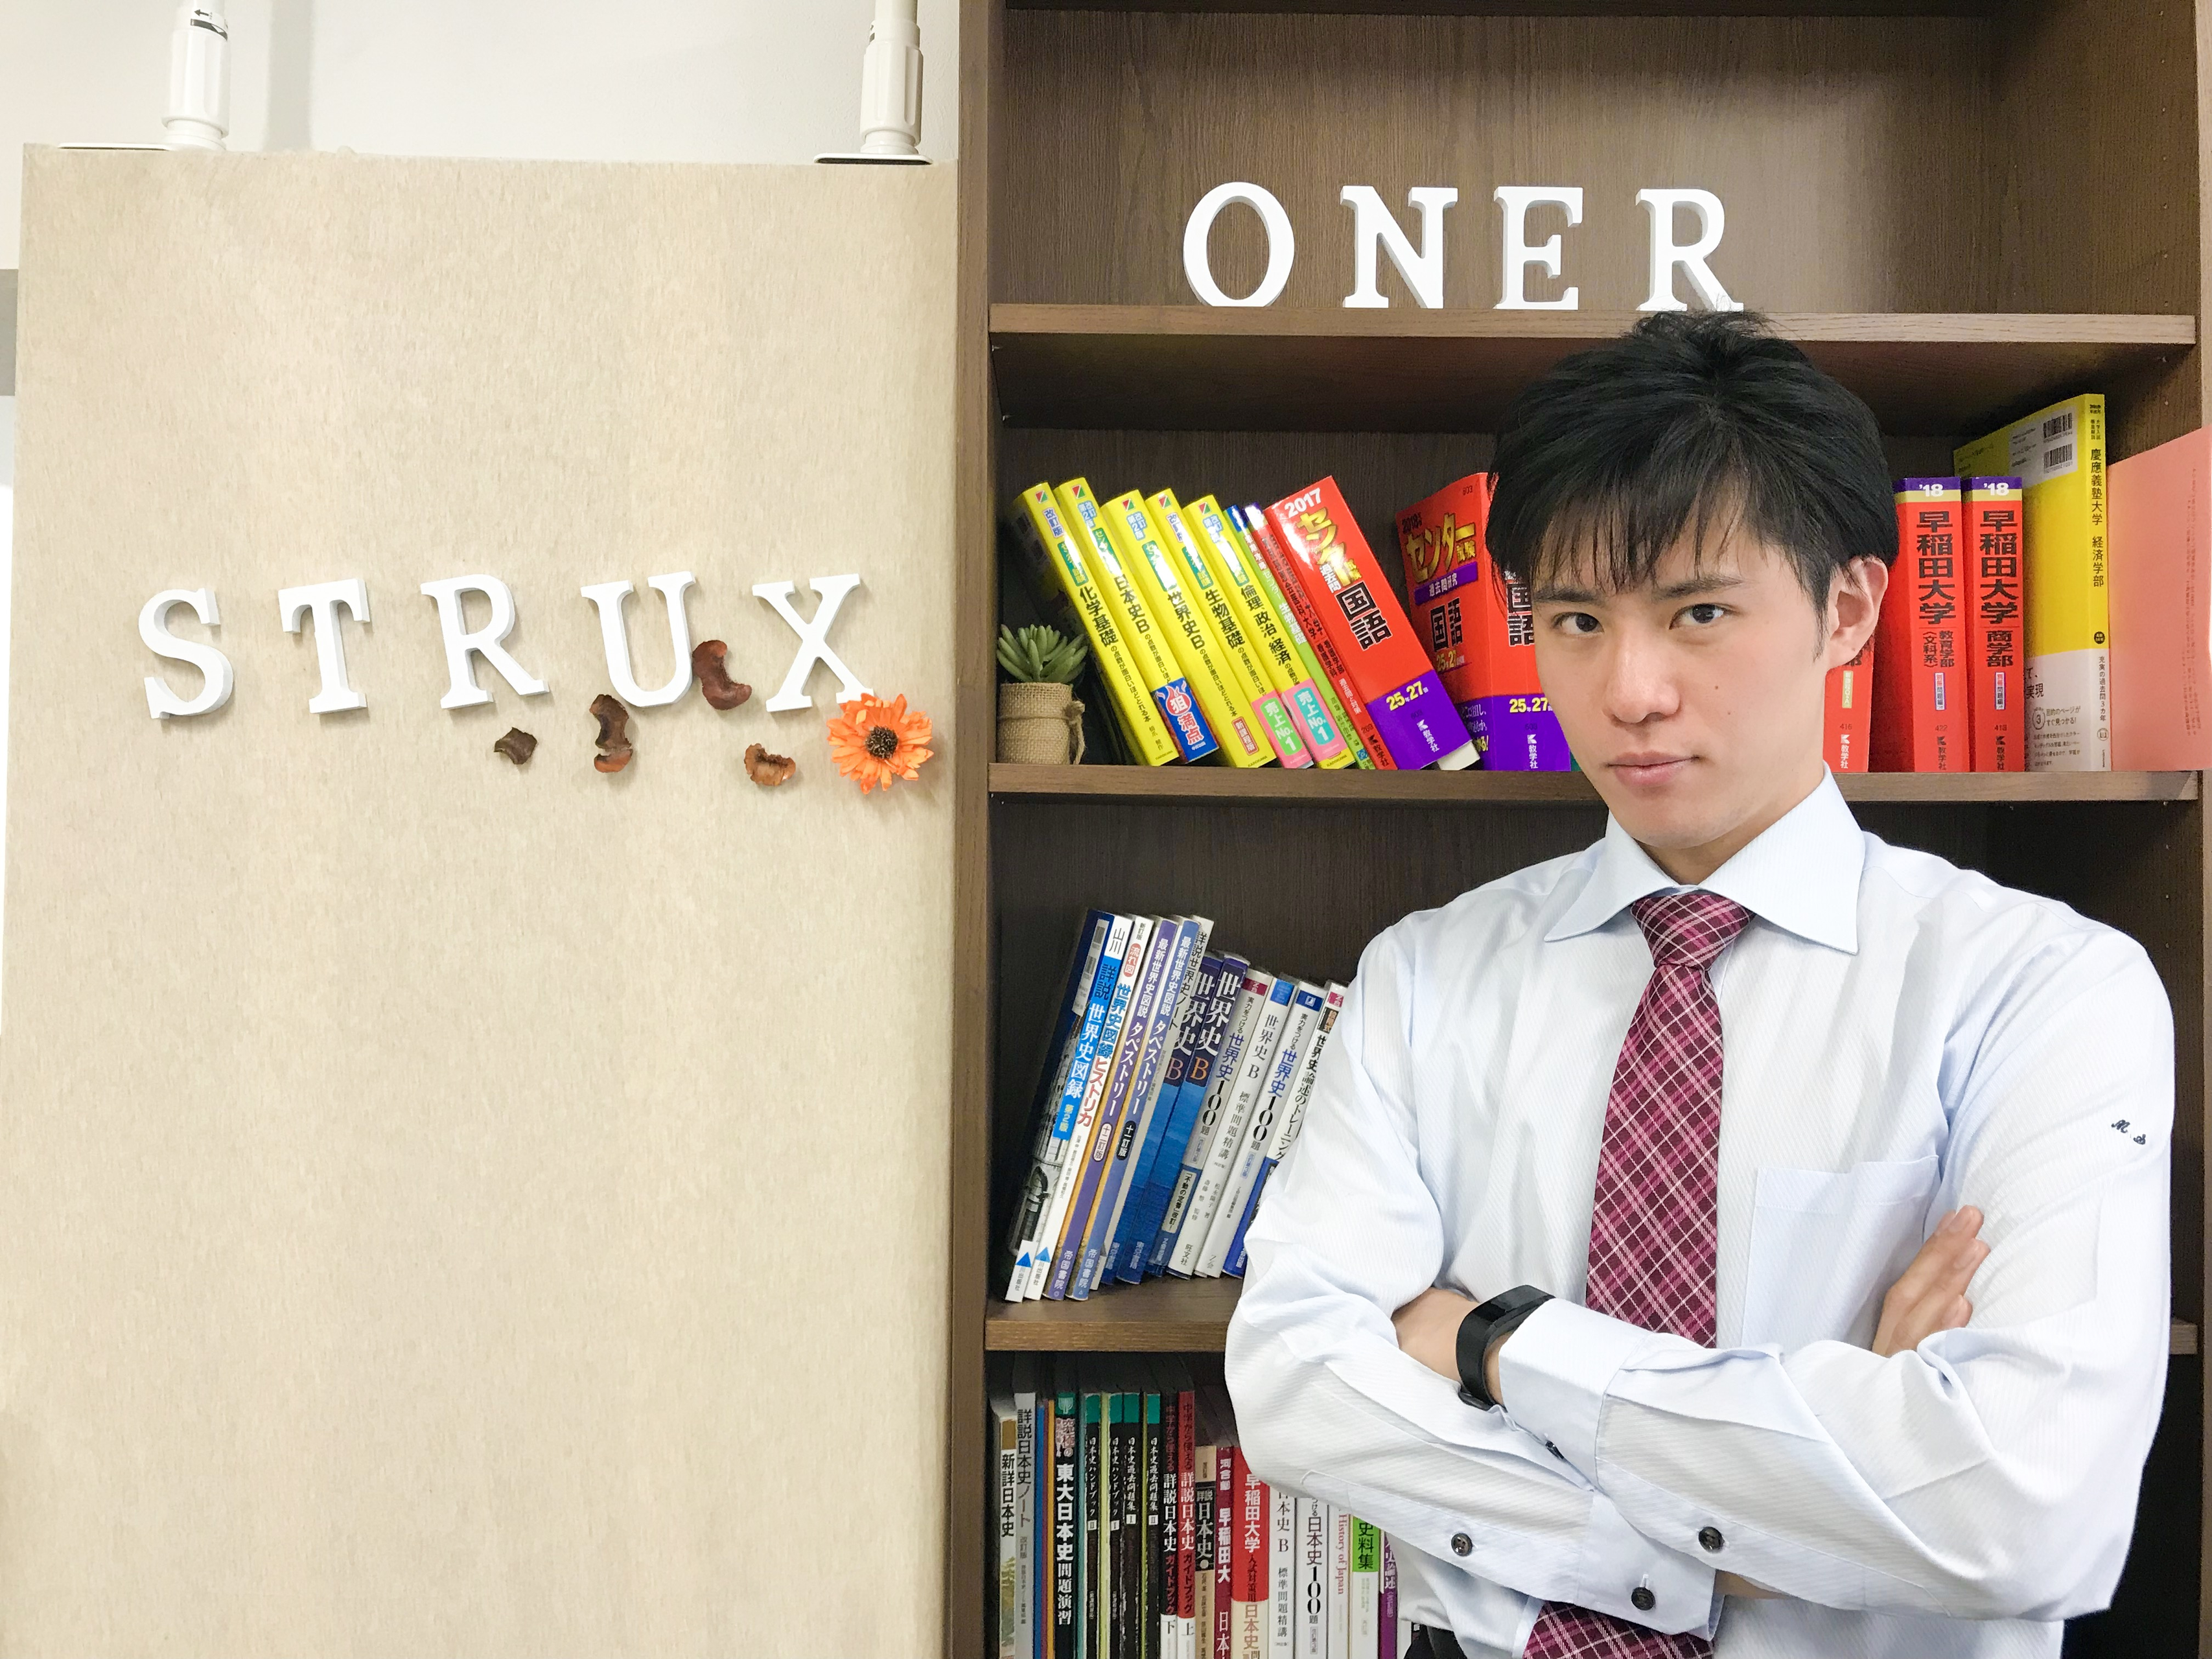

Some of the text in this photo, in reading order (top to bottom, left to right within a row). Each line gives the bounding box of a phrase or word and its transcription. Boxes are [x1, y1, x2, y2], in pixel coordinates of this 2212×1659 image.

[1183, 181, 1744, 311] ONER
[1284, 487, 1321, 518] 2017
[1918, 483, 1944, 498] '18
[1983, 483, 2009, 497] '18
[2090, 448, 2103, 526] 慶應義塾大学
[1406, 512, 1476, 584] センター
[1916, 510, 1956, 625] 早稲田大学
[1979, 509, 2019, 625] 早稲田大学
[2091, 535, 2105, 588] 経済学部
[1080, 585, 1118, 645] 化学基礎
[1113, 574, 1150, 633] 日本史B
[1167, 585, 1206, 651] 世界史B
[1204, 588, 1246, 650] 生物基礎
[1279, 601, 1308, 645] 生物基礎
[1336, 581, 1393, 652] 国語
[1430, 596, 1463, 653] 国語
[137, 570, 875, 719] STRUX
[1939, 630, 1955, 668] 教育学部
[1986, 629, 2014, 668] 商学部
[1177, 711, 1205, 746] 満点
[1235, 720, 1255, 752] 新課程版
[1422, 729, 1440, 753] 教学社
[1839, 723, 1853, 731] 416
[1528, 744, 1539, 770] 教学社
[1839, 744, 1850, 770] 教学社
[1937, 746, 1948, 771] 教学社
[1996, 746, 2005, 771] 教学社
[1108, 926, 1126, 955] 山川
[1123, 946, 1141, 975] 流れ図
[1095, 963, 1117, 1001] 詳説
[1136, 938, 1169, 1019] 最新世界史図説
[1159, 935, 1192, 1017] 最新世界史図説
[1169, 931, 1207, 1031] 詳説世界史ノート
[1237, 996, 1255, 1034] 実力をつける
[1290, 1013, 1309, 1050] 実力をつける
[1065, 1003, 1106, 1099] 世界史図録
[1108, 1021, 1144, 1117] タペストリー
[1132, 1019, 1166, 1115] タペストリー
[1218, 1091, 1250, 1160] 標準問題精講
[1053, 1249, 1073, 1290] 帝国書院
[1077, 1248, 1097, 1288] 帝国書院
[1180, 1244, 1194, 1266] 旺文社
[1001, 1453, 1015, 1537] 新詳日本史
[1017, 1408, 1032, 1528] 詳説日本史ノート
[1088, 1437, 1097, 1516] 日本史ハンドブック
[1112, 1437, 1121, 1516] 日本史ハンドブック
[1163, 1472, 1178, 1552] 詳説日本史
[1180, 1471, 1195, 1551] 詳説日本史
[1244, 1473, 1261, 1553] 早稲田大学
[1334, 1514, 1348, 1595] History of Japan
[1357, 1522, 1375, 1570] 史料集
[1161, 1619, 1176, 1634] 下
[1181, 1621, 1195, 1636] 上
[1244, 1603, 1260, 1650] 日本史
[1277, 1566, 1288, 1638] 標準問題精講
[1216, 1611, 1230, 1659] 日本
